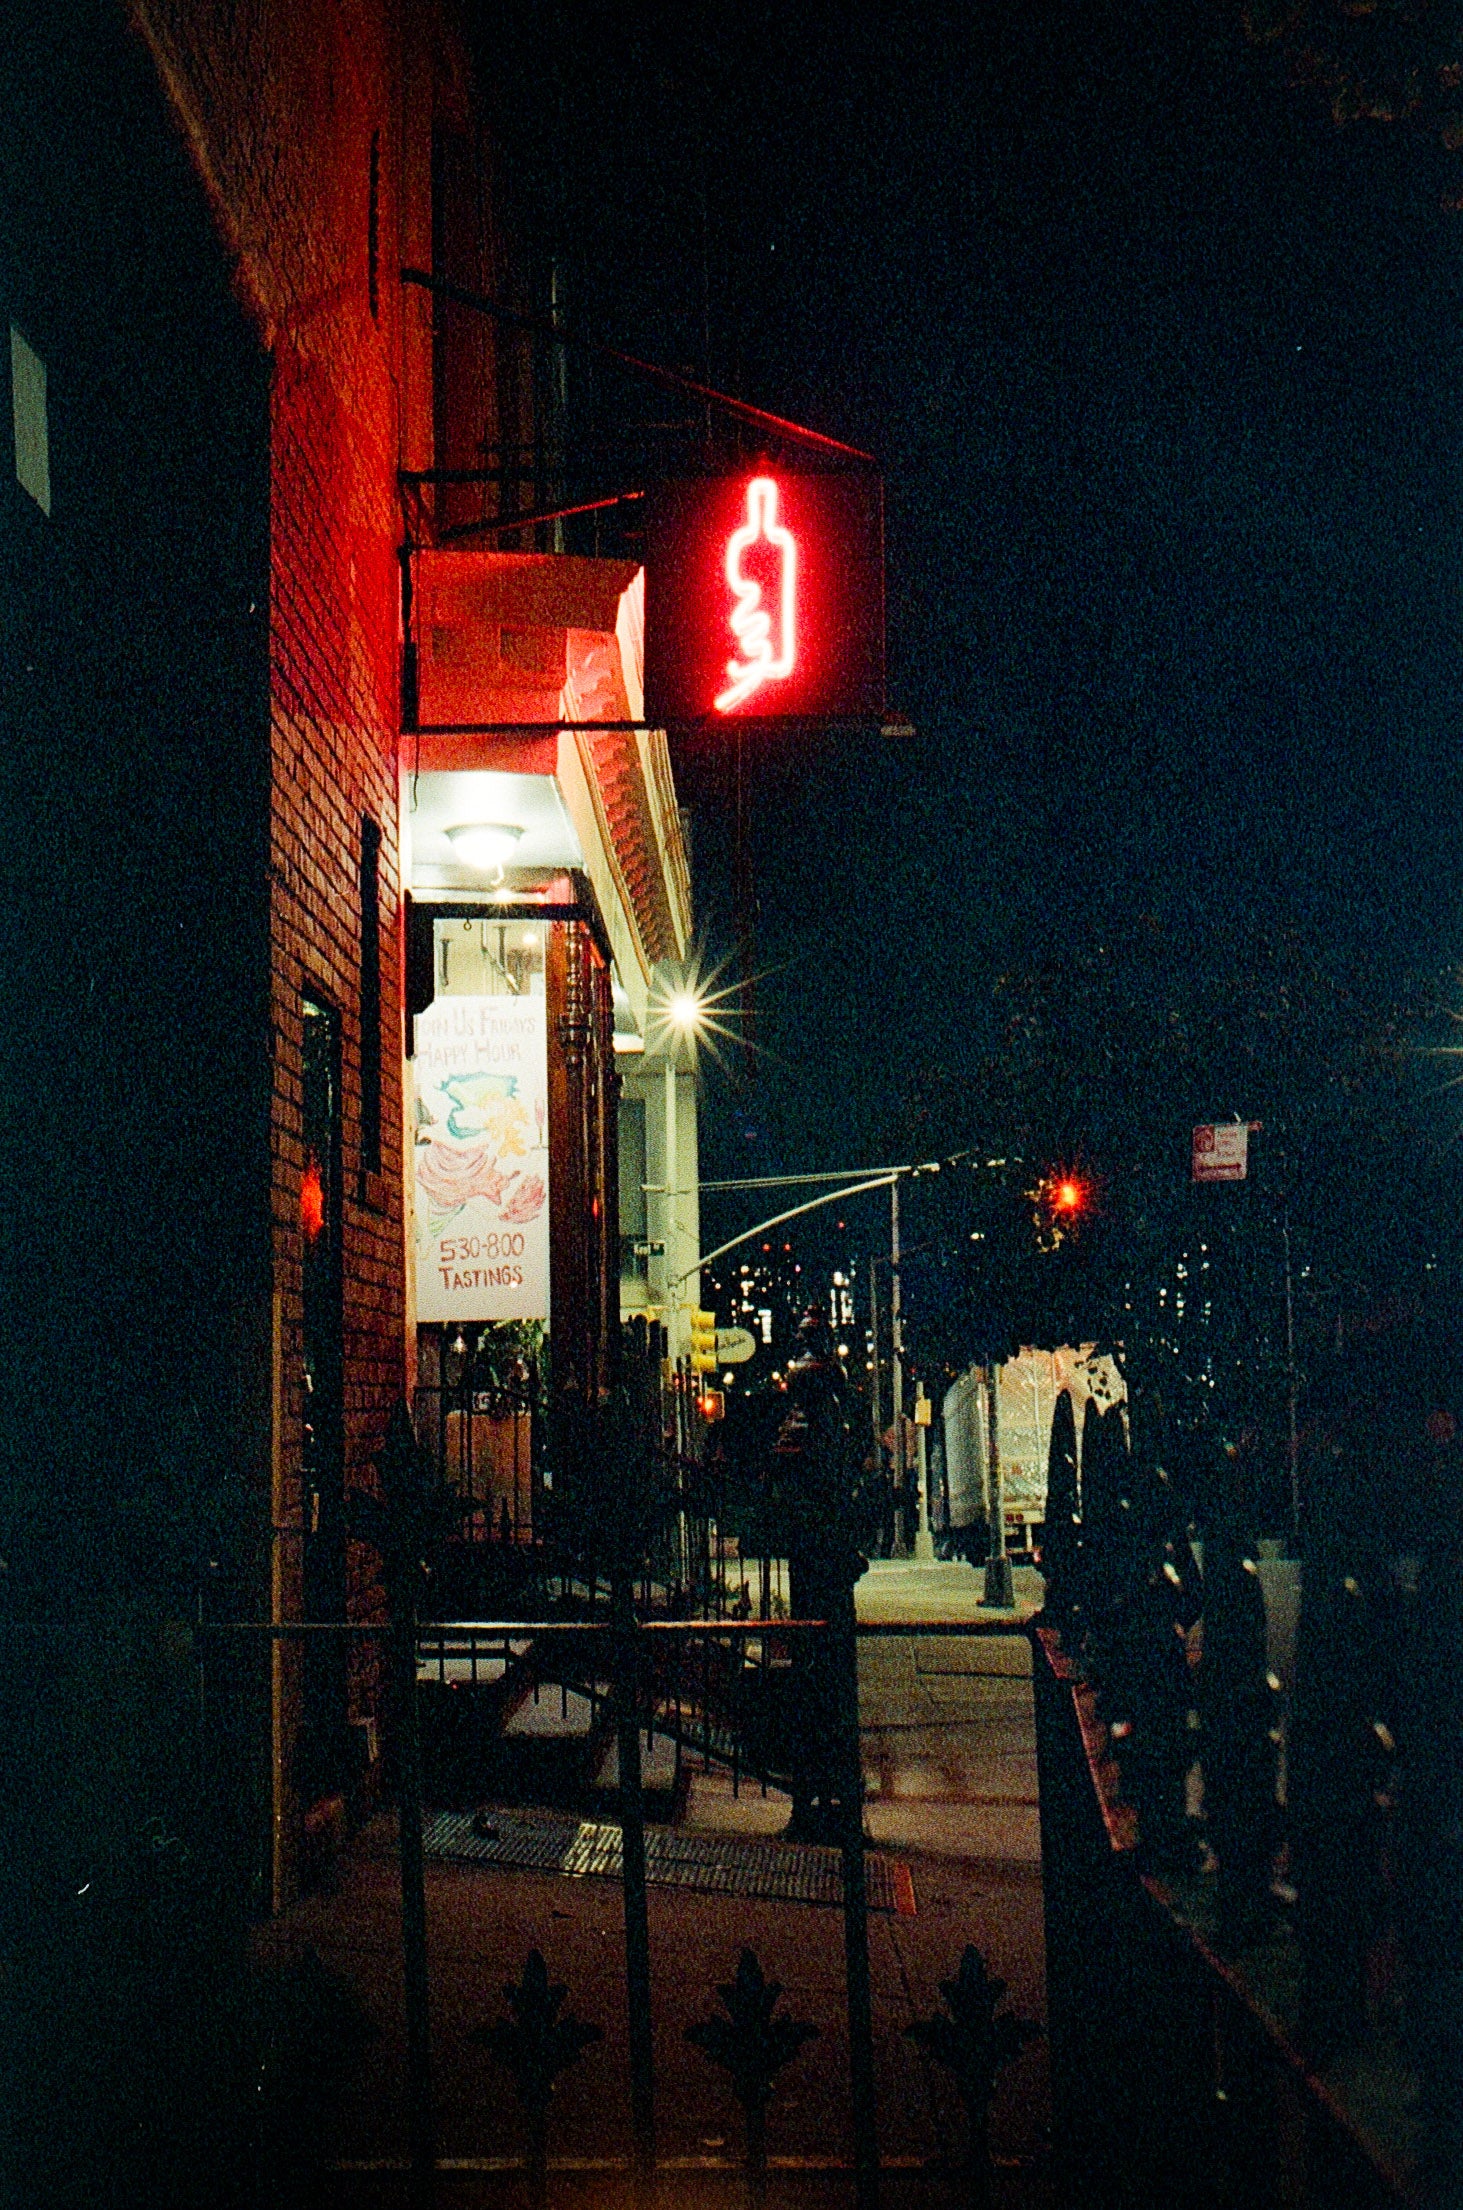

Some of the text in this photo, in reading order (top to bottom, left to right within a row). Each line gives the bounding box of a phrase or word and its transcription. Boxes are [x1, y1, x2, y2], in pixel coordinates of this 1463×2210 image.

[417, 1039, 522, 1067] HAPPY HOUR
[440, 1232, 525, 1261] 530-800
[438, 1265, 523, 1290] TASTINGS
